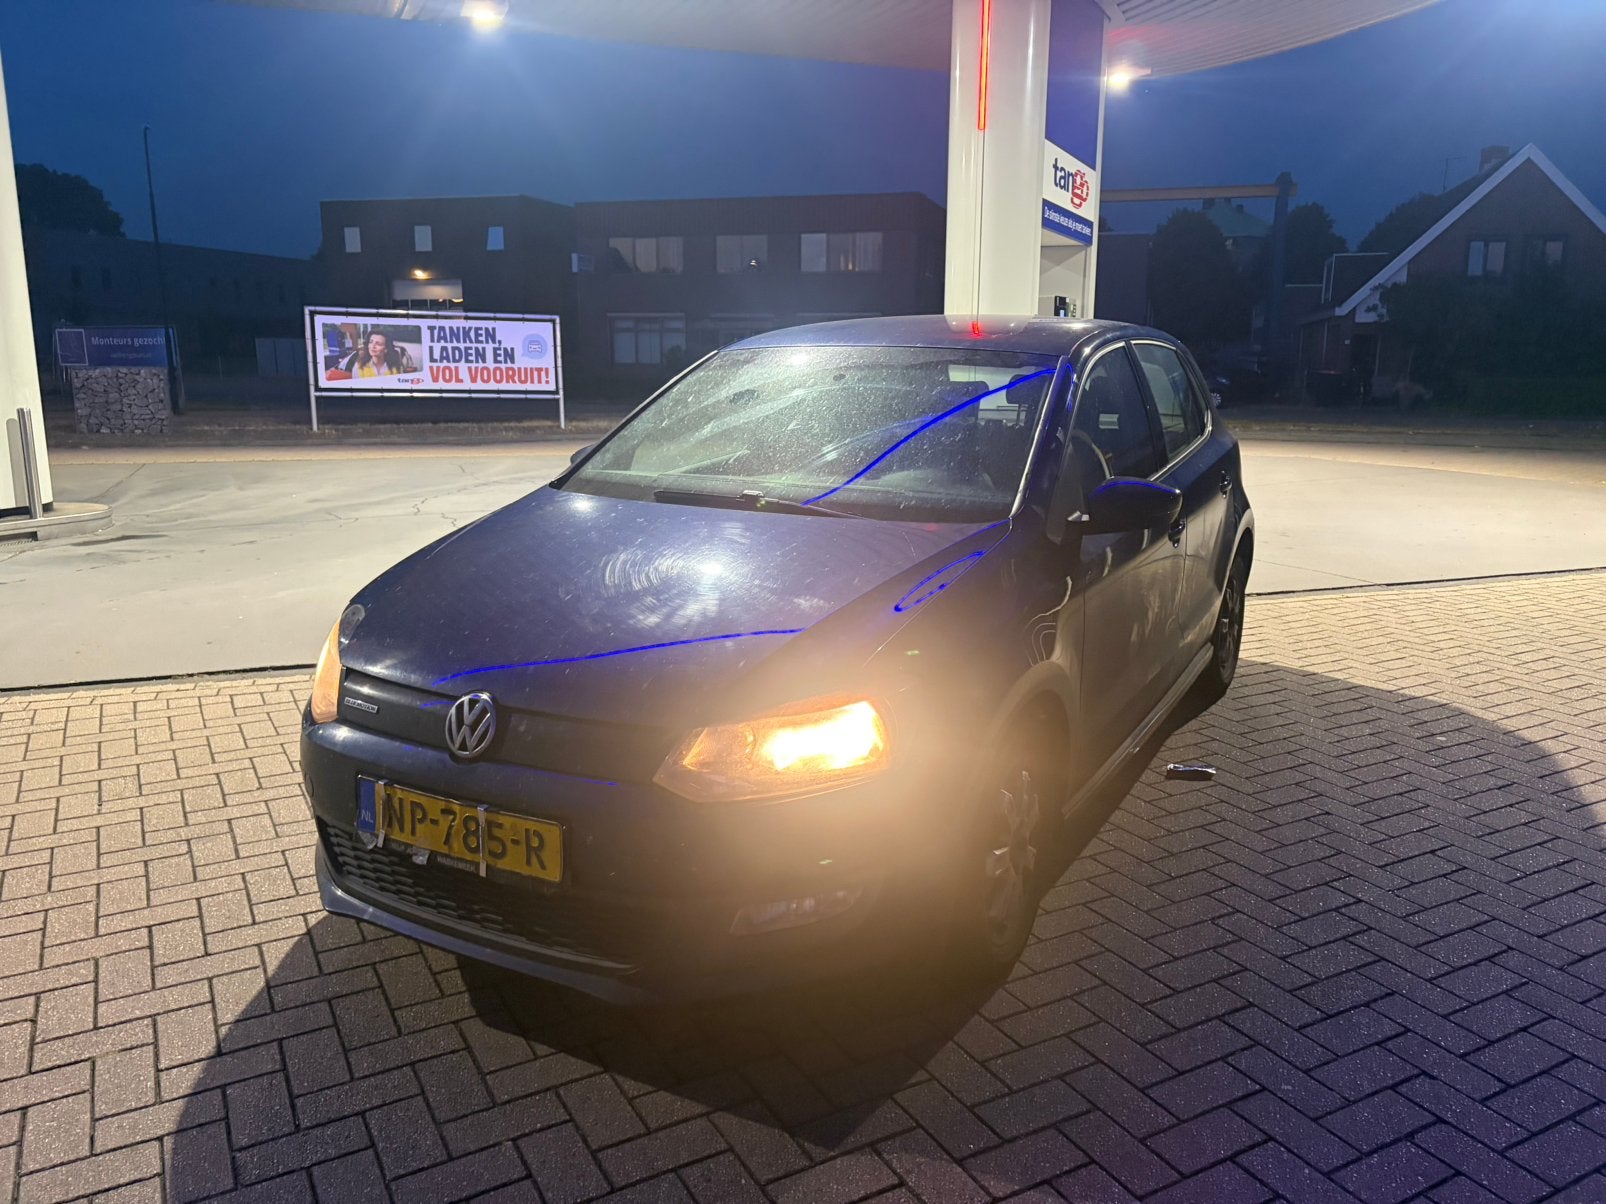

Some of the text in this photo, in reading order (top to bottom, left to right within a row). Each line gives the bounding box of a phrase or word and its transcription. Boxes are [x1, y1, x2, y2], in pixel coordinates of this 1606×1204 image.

[1052, 157, 1090, 210] tango
[91, 336, 131, 345] Monteurs
[427, 325, 502, 346] TANKEN,
[428, 346, 487, 364] LADEN
[429, 365, 550, 385] VOL VOORUIT!
[361, 811, 374, 823] NL
[384, 793, 546, 871] NP-785-R
